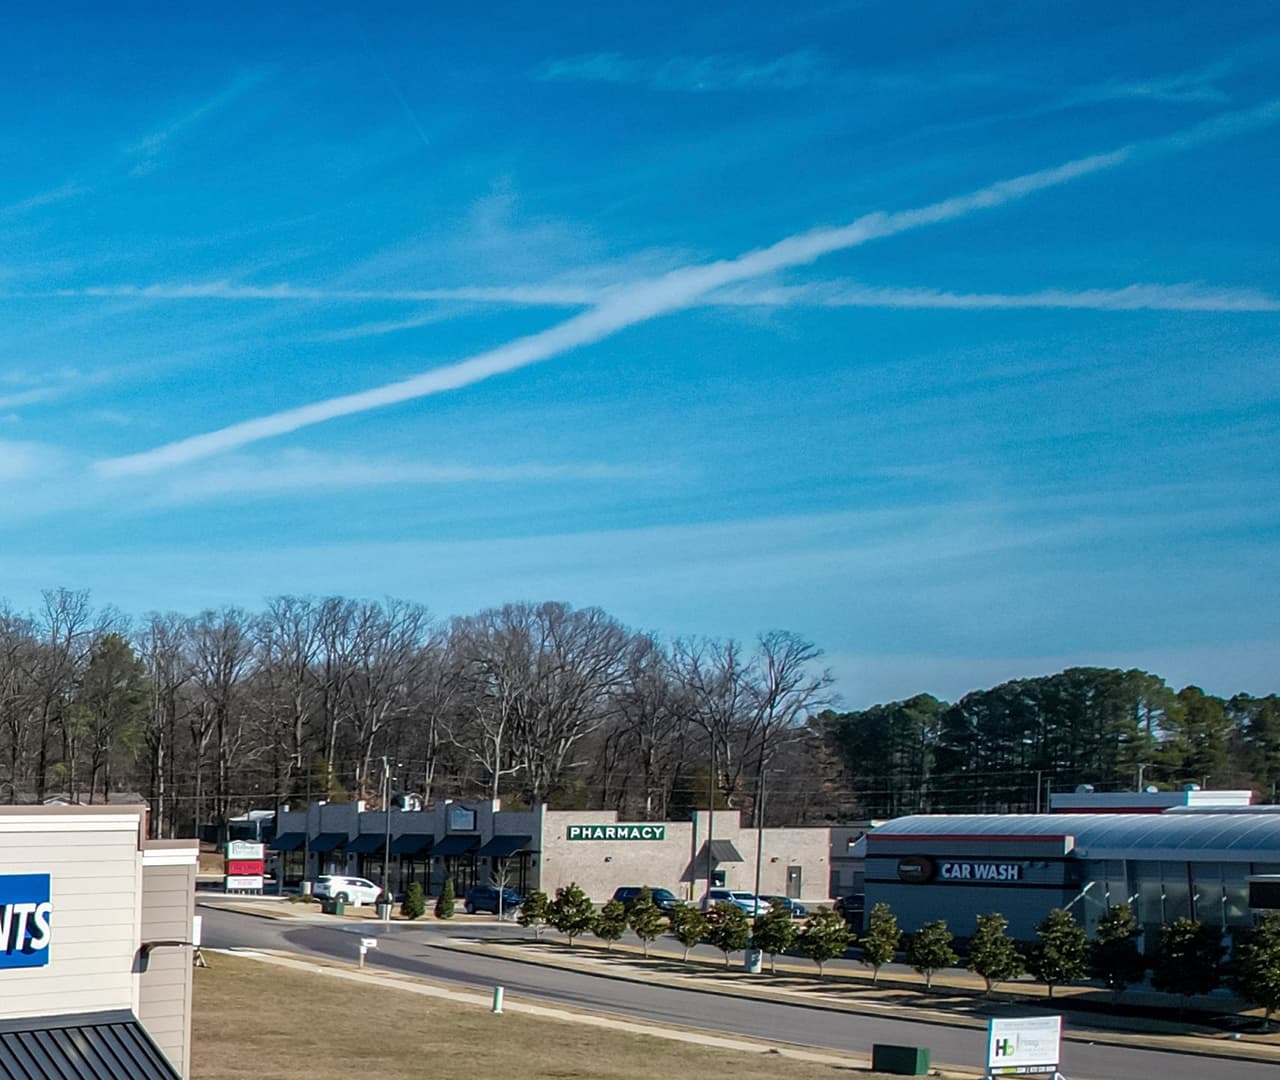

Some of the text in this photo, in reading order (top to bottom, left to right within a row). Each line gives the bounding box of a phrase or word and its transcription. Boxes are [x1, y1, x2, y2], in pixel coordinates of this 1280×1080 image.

[570, 827, 663, 838] PHARMACY
[941, 863, 971, 879] CAR
[974, 864, 1018, 880] WASH
